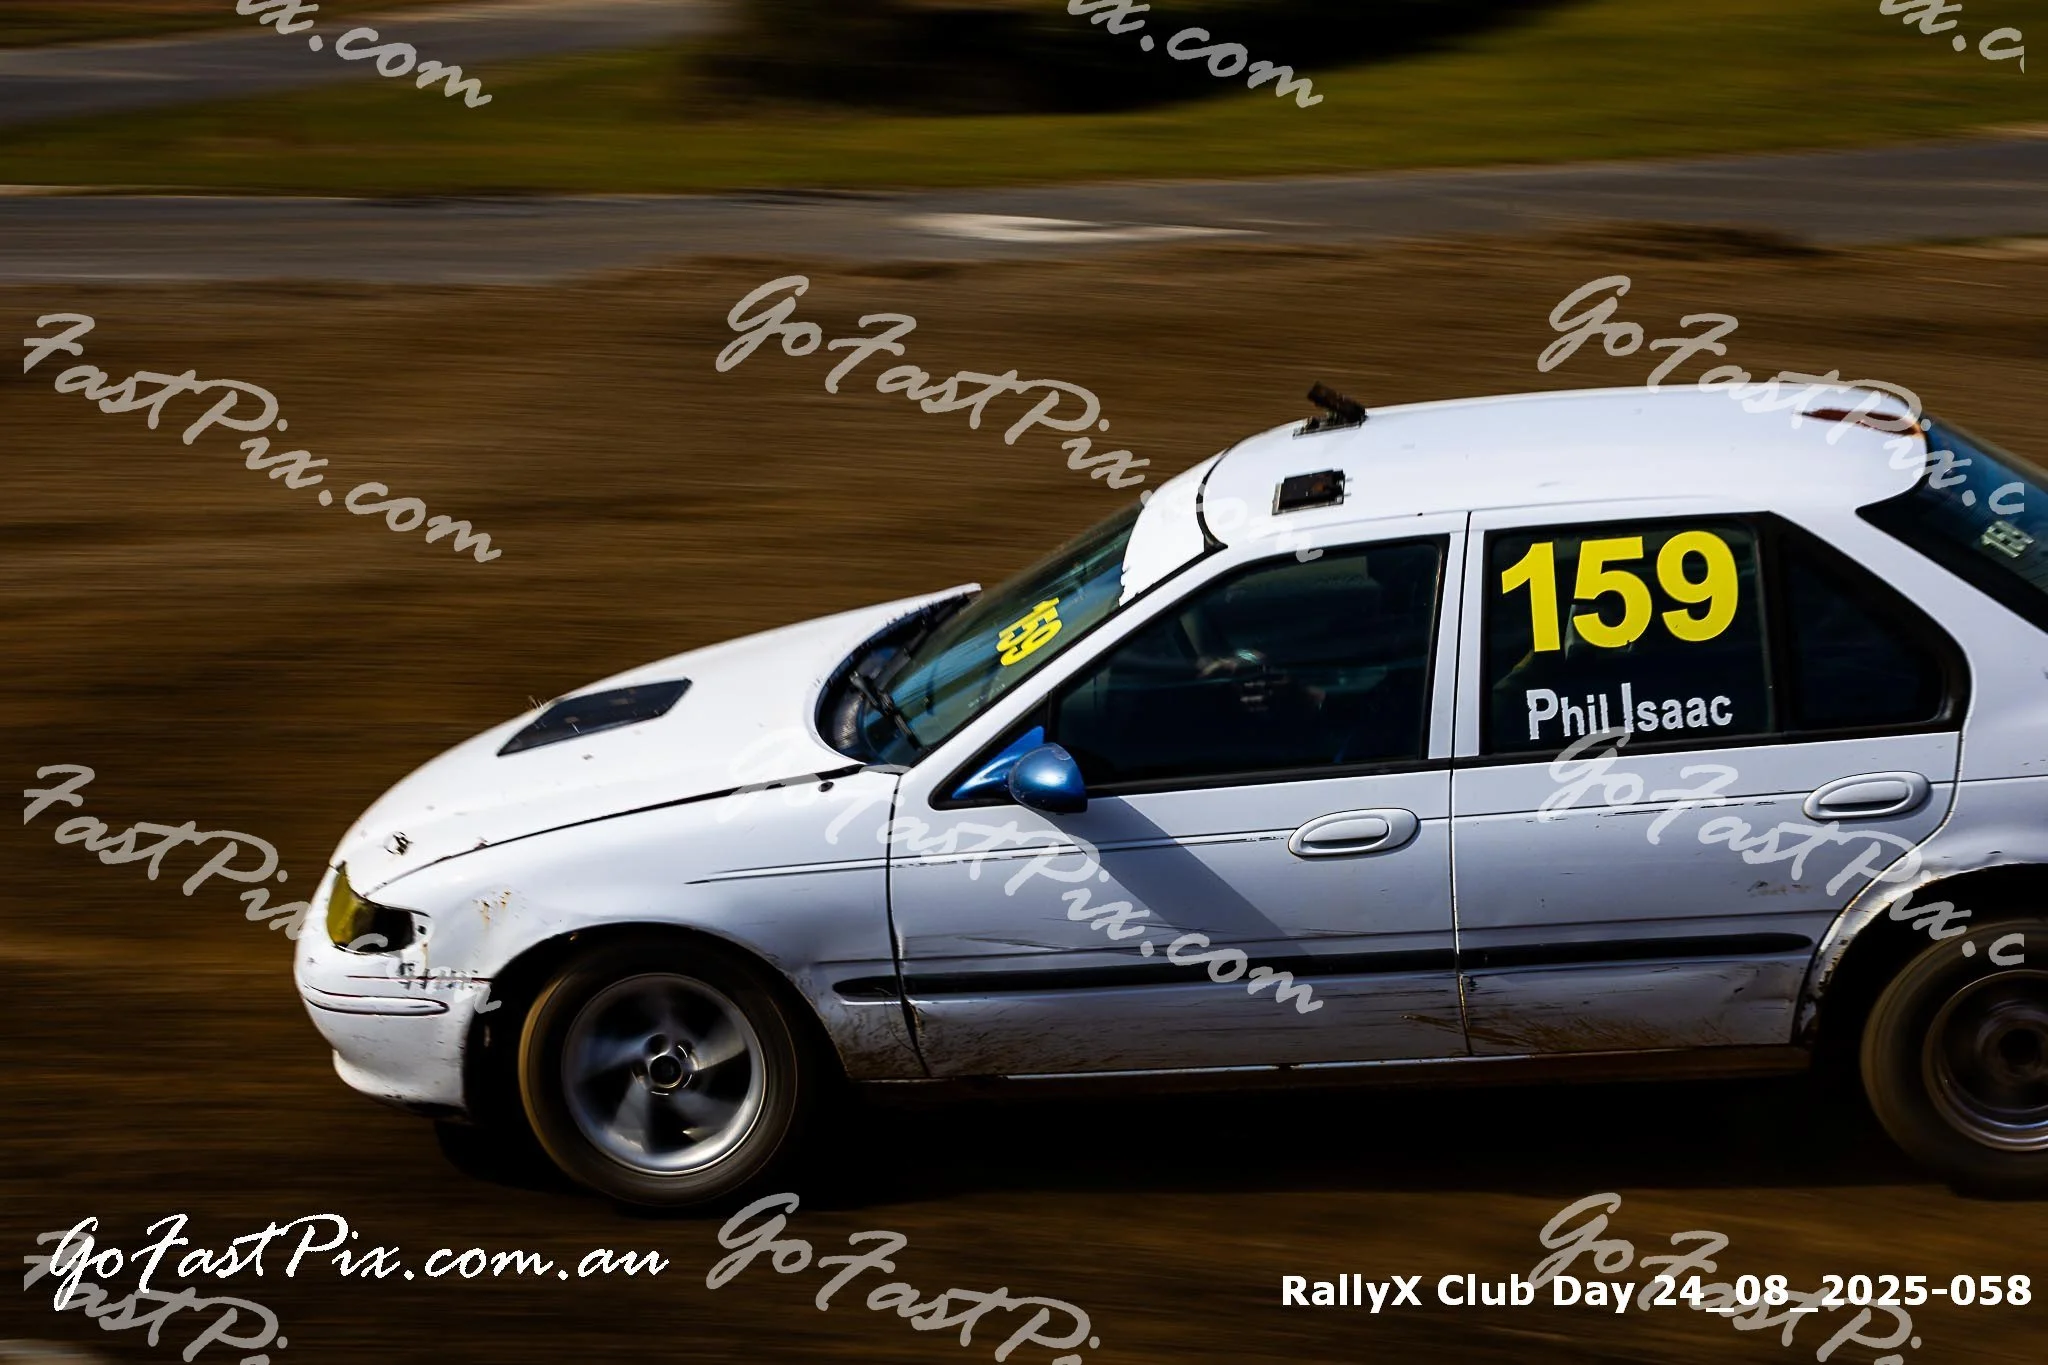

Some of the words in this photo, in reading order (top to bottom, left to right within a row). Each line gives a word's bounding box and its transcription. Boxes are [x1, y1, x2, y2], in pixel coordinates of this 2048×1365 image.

[1501, 531, 1739, 652] 159
[996, 597, 1063, 666] 159
[1526, 688, 1610, 740] Phil
[1621, 682, 1733, 734] Isaac
